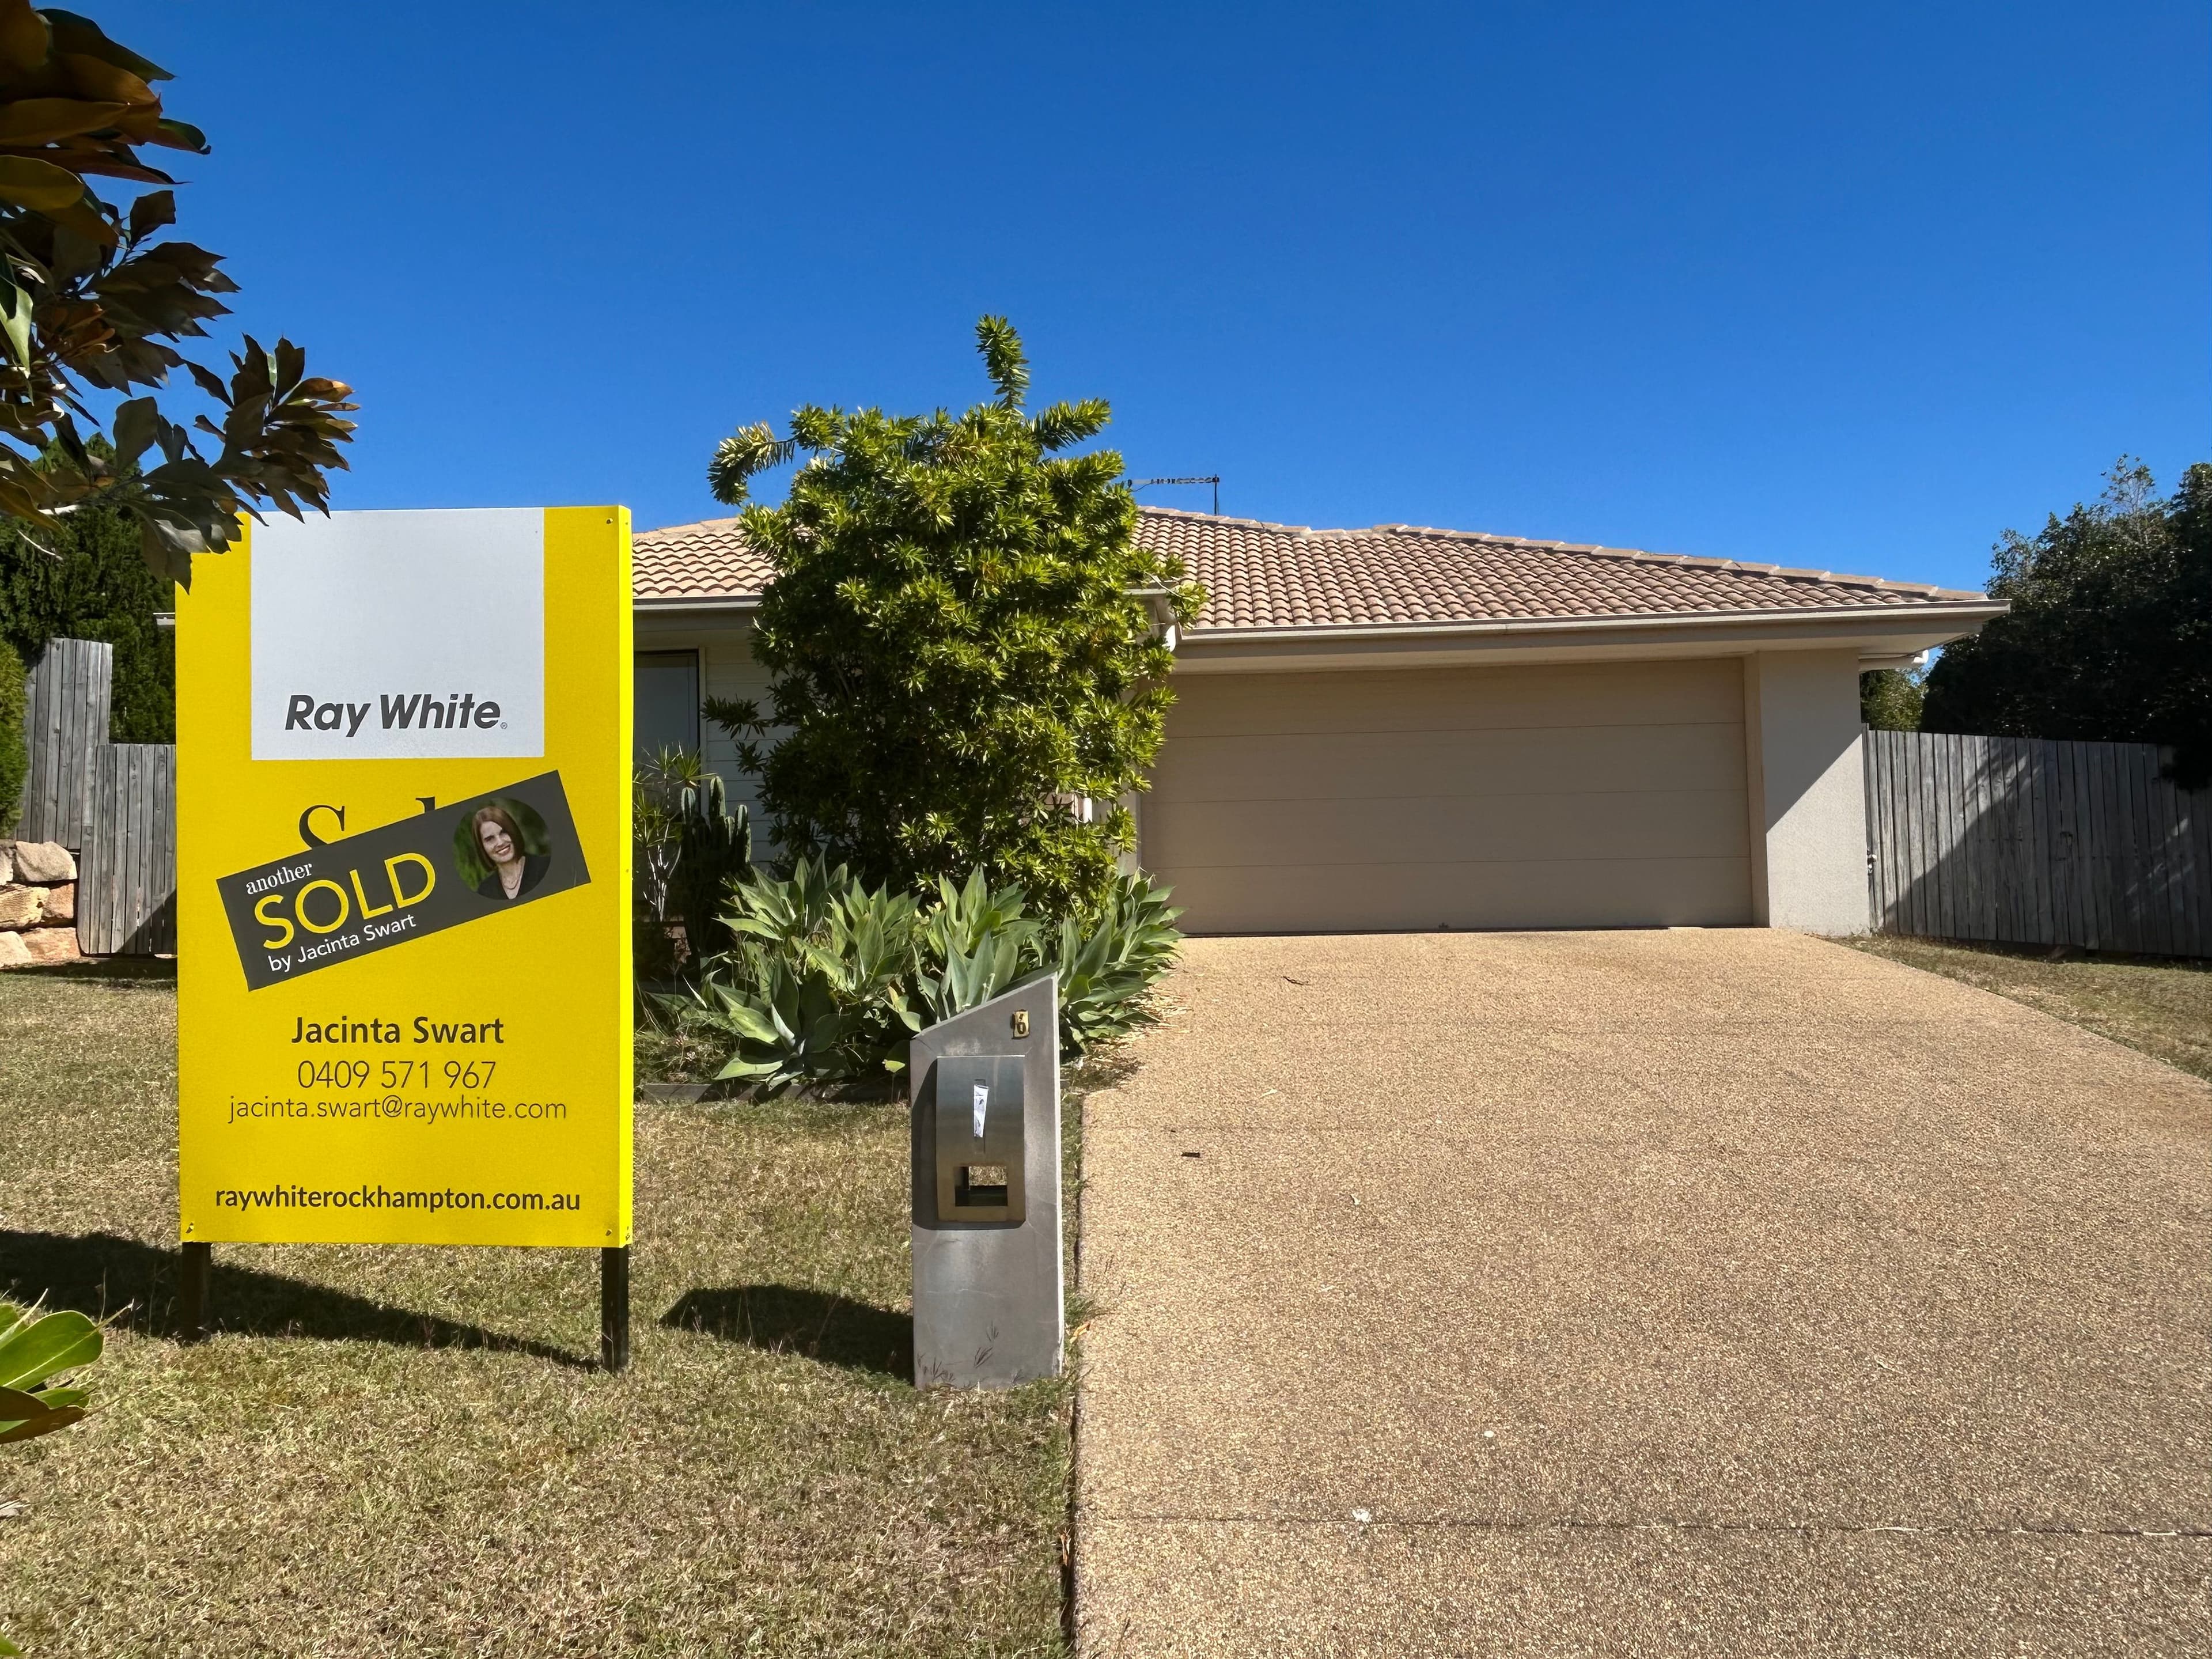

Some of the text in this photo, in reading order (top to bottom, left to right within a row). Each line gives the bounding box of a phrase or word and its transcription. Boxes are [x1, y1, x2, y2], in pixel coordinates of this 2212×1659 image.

[285, 695, 371, 737] Ray
[246, 862, 313, 895] another
[255, 853, 436, 949] SOLD
[268, 914, 416, 973] by Jacinta Swart
[292, 1015, 504, 1044] Jacinta Swart
[1016, 1013, 1027, 1035] 6
[298, 1060, 496, 1089] 0409 571 967
[228, 1094, 566, 1125] jacinta.swart@raywhite.com
[216, 1184, 579, 1213] raywhiterockhampton.com.au
